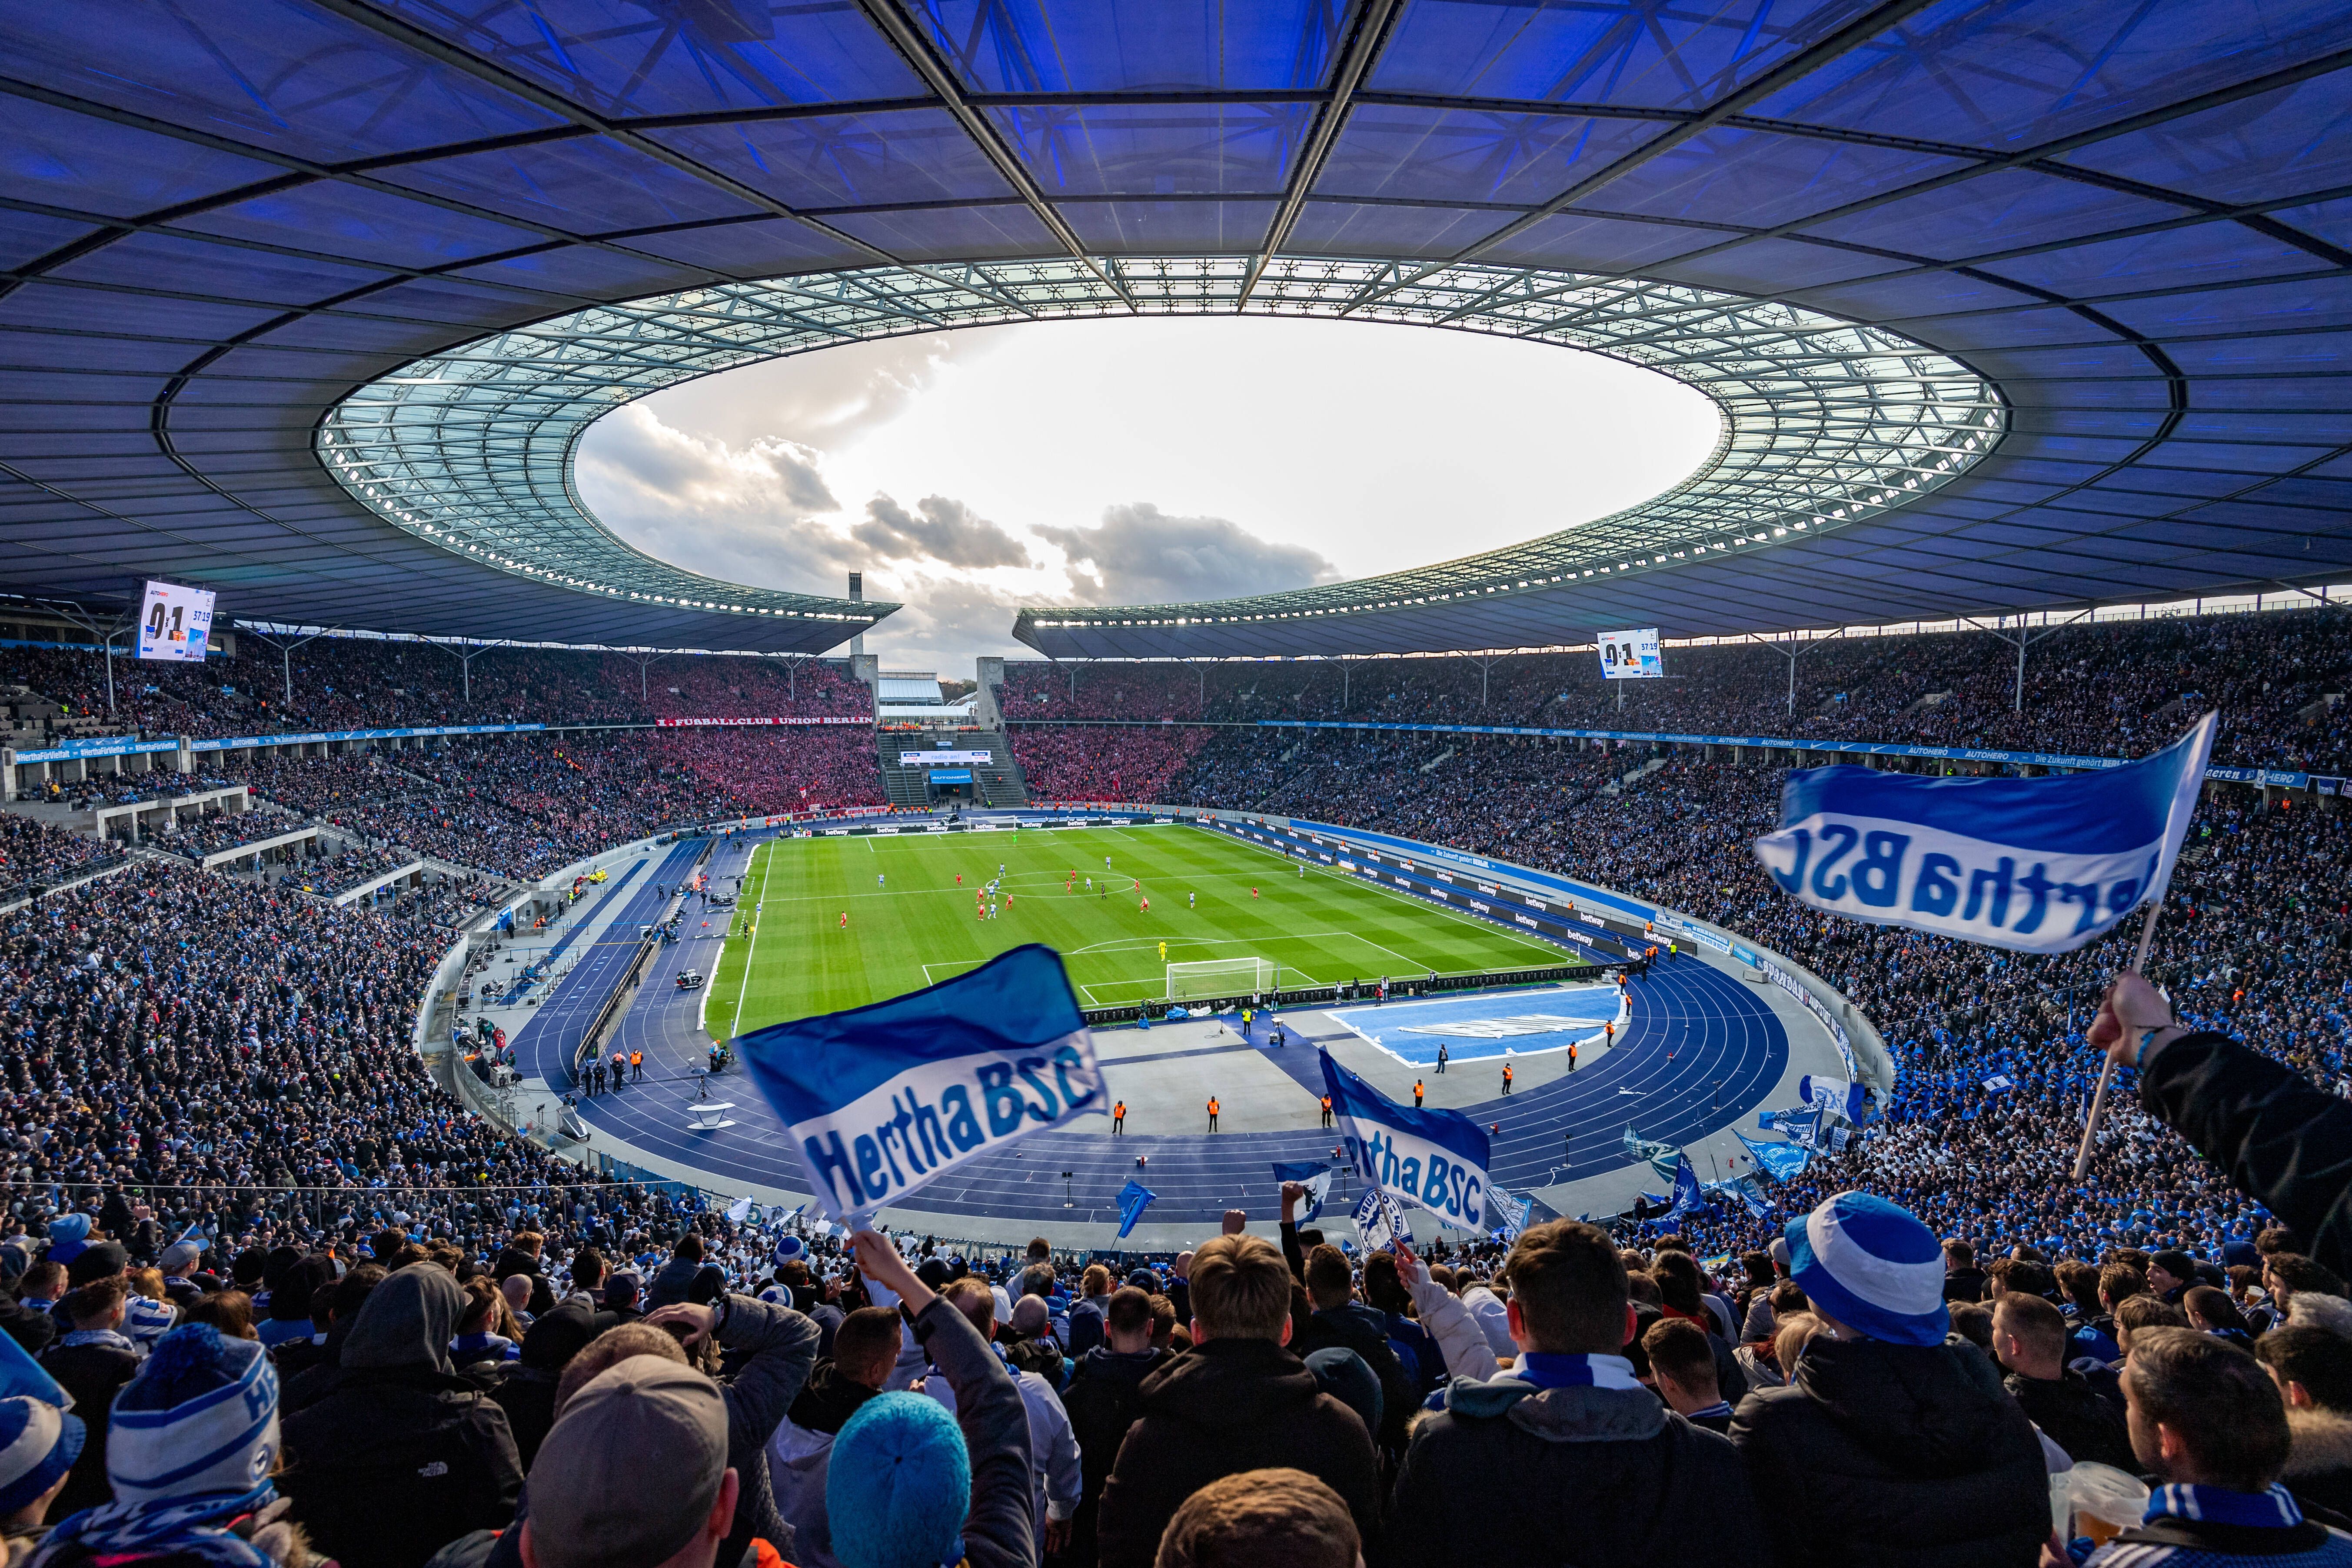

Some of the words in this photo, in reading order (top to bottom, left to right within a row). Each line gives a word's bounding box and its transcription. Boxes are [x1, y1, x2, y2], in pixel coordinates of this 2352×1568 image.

[150, 603, 165, 639] 0
[168, 606, 183, 640] 1
[1606, 644, 1618, 666] 0
[1622, 643, 1635, 666] 1
[136, 742, 177, 752] #HerthaFürVielfalt
[192, 740, 220, 749] AUTOHERO
[232, 738, 259, 746] AUTOHERO
[16, 750, 70, 762] #HerthaFürVielfalt
[80, 746, 126, 757] #HerthaFürVielfalt
[1908, 747, 1948, 756] AUTOHERO
[1965, 750, 2009, 760] AUTOHERO
[2047, 756, 2076, 765] Zukunft
[2076, 758, 2101, 767] gehört
[1312, 837, 1323, 846] betway
[1296, 846, 1307, 856] betway
[1338, 844, 1351, 854] betway
[1320, 853, 1332, 863] betway
[1367, 852, 1381, 863] betway
[1443, 851, 1459, 860] Zukunft
[1459, 855, 1473, 864] gehört
[1364, 866, 1378, 878] betway
[1400, 862, 1415, 873] betway
[1395, 876, 1411, 889] betway
[1437, 872, 1453, 884] betway
[1430, 887, 1448, 900] betway
[1478, 883, 1497, 897] betway
[1470, 899, 1490, 914] betway
[1526, 897, 1547, 911] betway
[1516, 913, 1538, 929] betway
[1580, 912, 1605, 928] betway
[1671, 918, 1682, 927] WEISS
[1567, 929, 1594, 947] betway
[1644, 930, 1673, 948] betway
[1763, 960, 1804, 1002] SPANDAU
